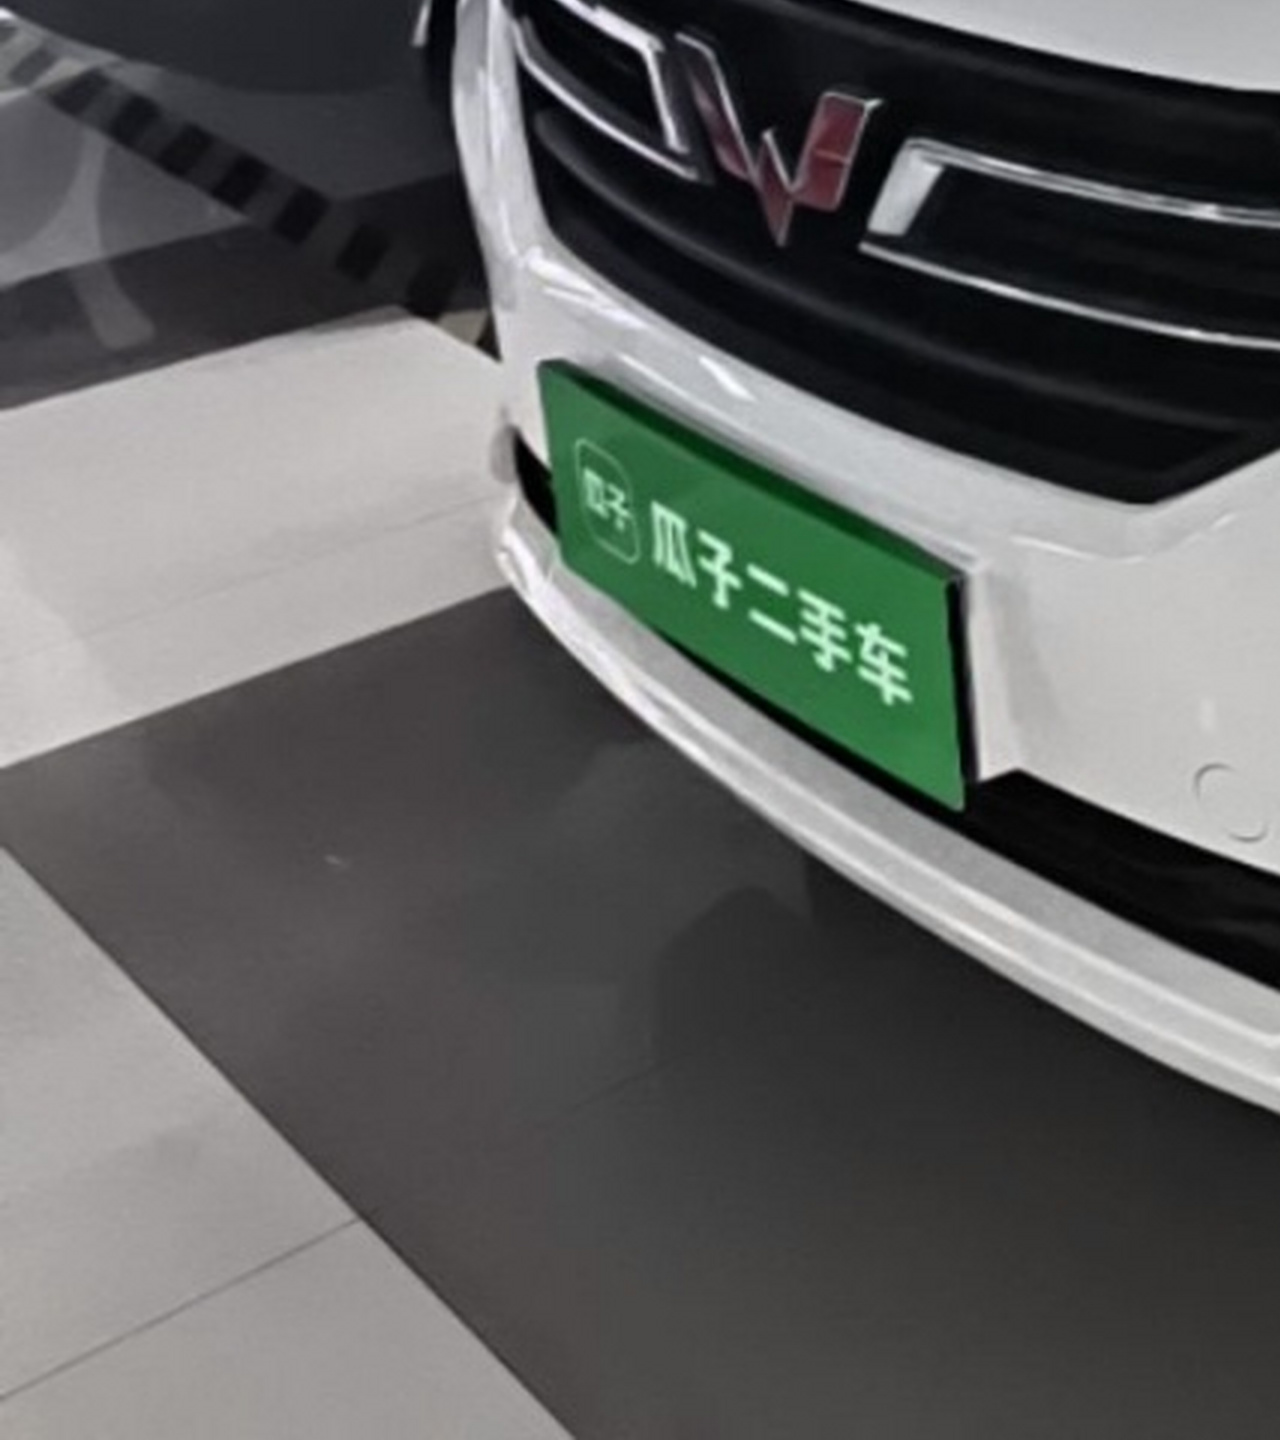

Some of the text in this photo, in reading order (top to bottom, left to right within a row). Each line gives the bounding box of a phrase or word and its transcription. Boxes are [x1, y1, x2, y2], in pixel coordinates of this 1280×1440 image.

[650, 499, 914, 707] 瓜子二手车
